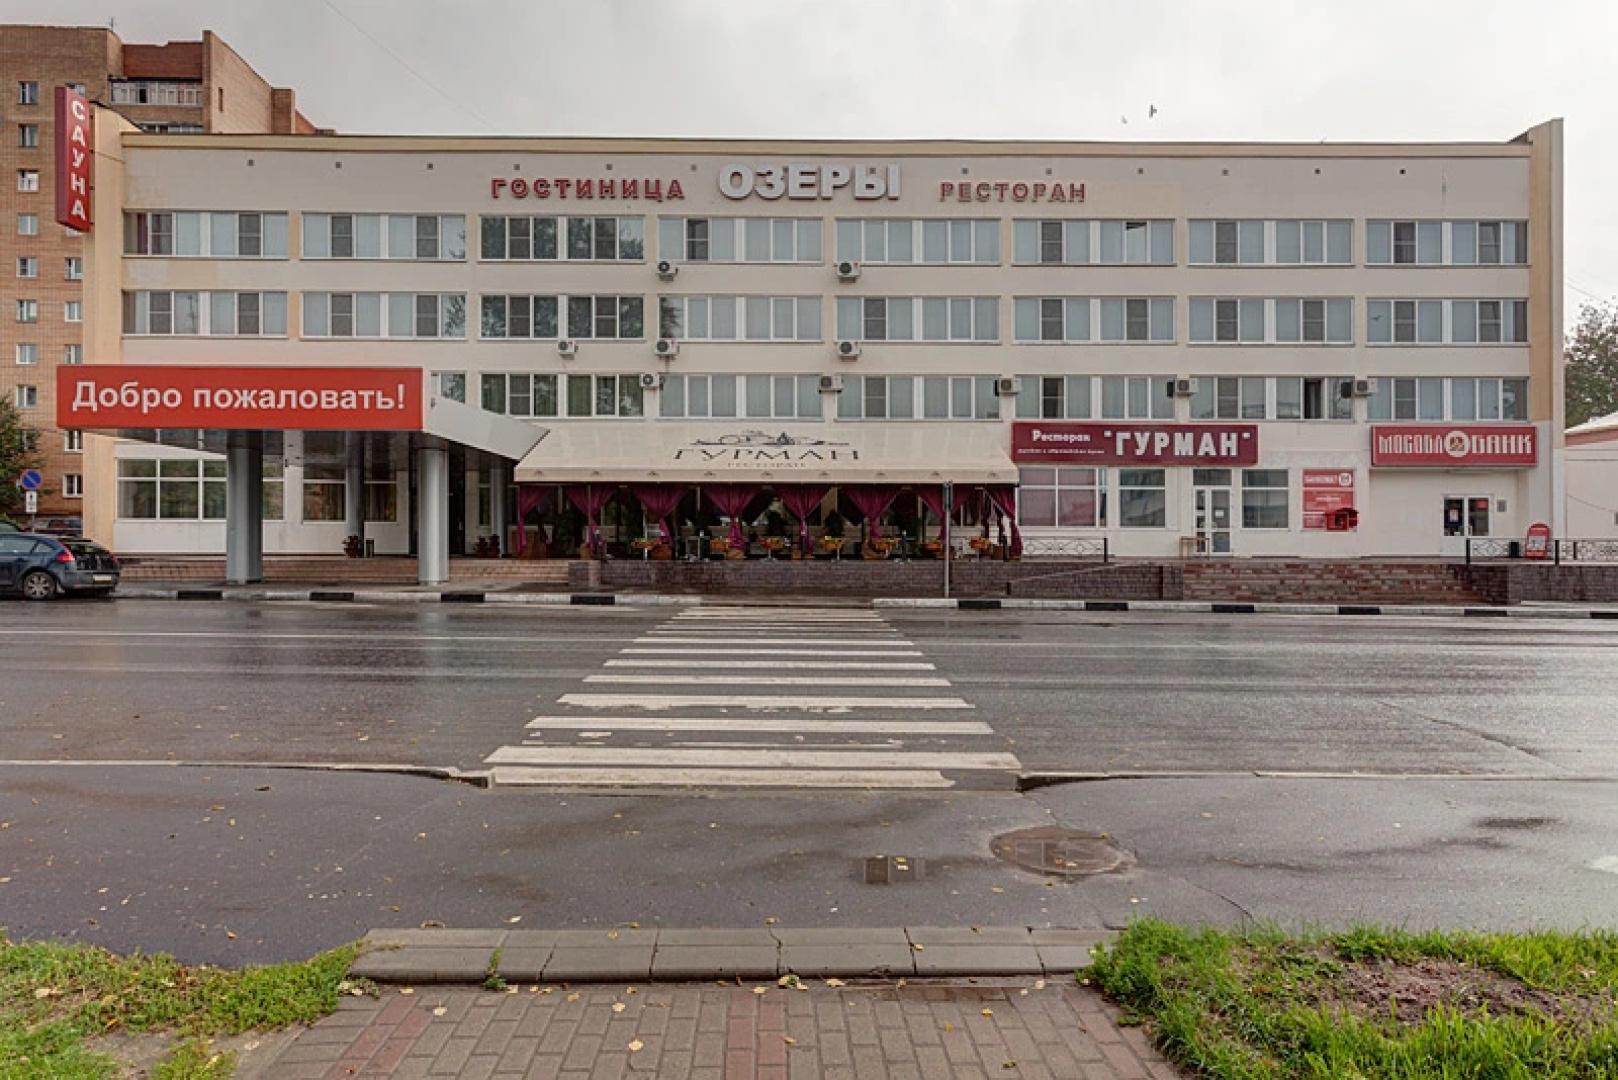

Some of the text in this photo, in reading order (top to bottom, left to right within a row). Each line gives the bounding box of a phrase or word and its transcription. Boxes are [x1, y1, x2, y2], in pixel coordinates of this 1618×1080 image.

[71, 100, 86, 221] САУНА
[490, 162, 1086, 203] ГОСТИНИЦА ОЗЕРЫ РЕСТОРАН
[72, 381, 406, 414] Добро пожаловать!
[1032, 429, 1091, 443] Ресторан
[674, 449, 859, 461] ГУРМАН
